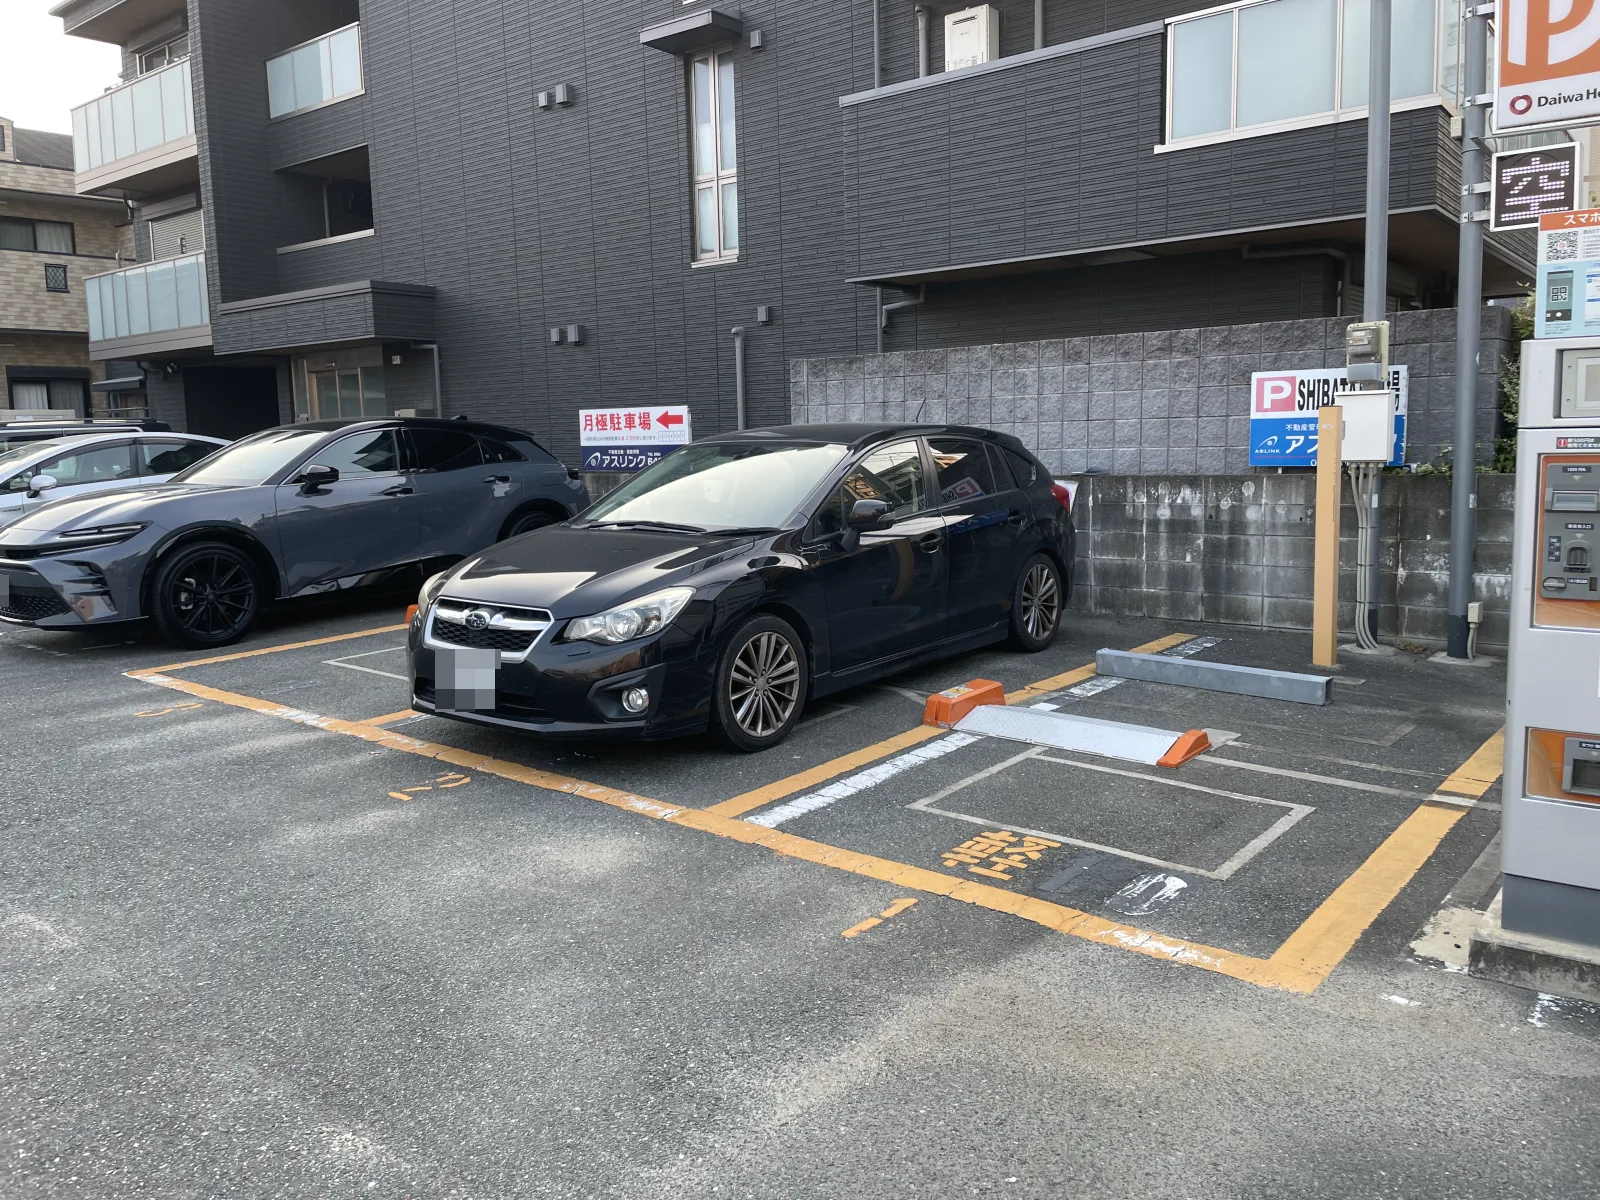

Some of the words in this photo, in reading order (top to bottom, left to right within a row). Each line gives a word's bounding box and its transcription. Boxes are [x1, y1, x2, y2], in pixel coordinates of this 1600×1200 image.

[1537, 93, 1583, 107] Daiwa
[1586, 88, 1600, 100] H
[1501, 157, 1570, 221] 空
[1563, 212, 1600, 226] スマホ
[1263, 380, 1292, 409] P
[1297, 377, 1362, 411] SHIBA
[583, 412, 651, 432] 月極駐車場
[602, 455, 646, 468] アスリンク
[941, 830, 1062, 881] 軽
